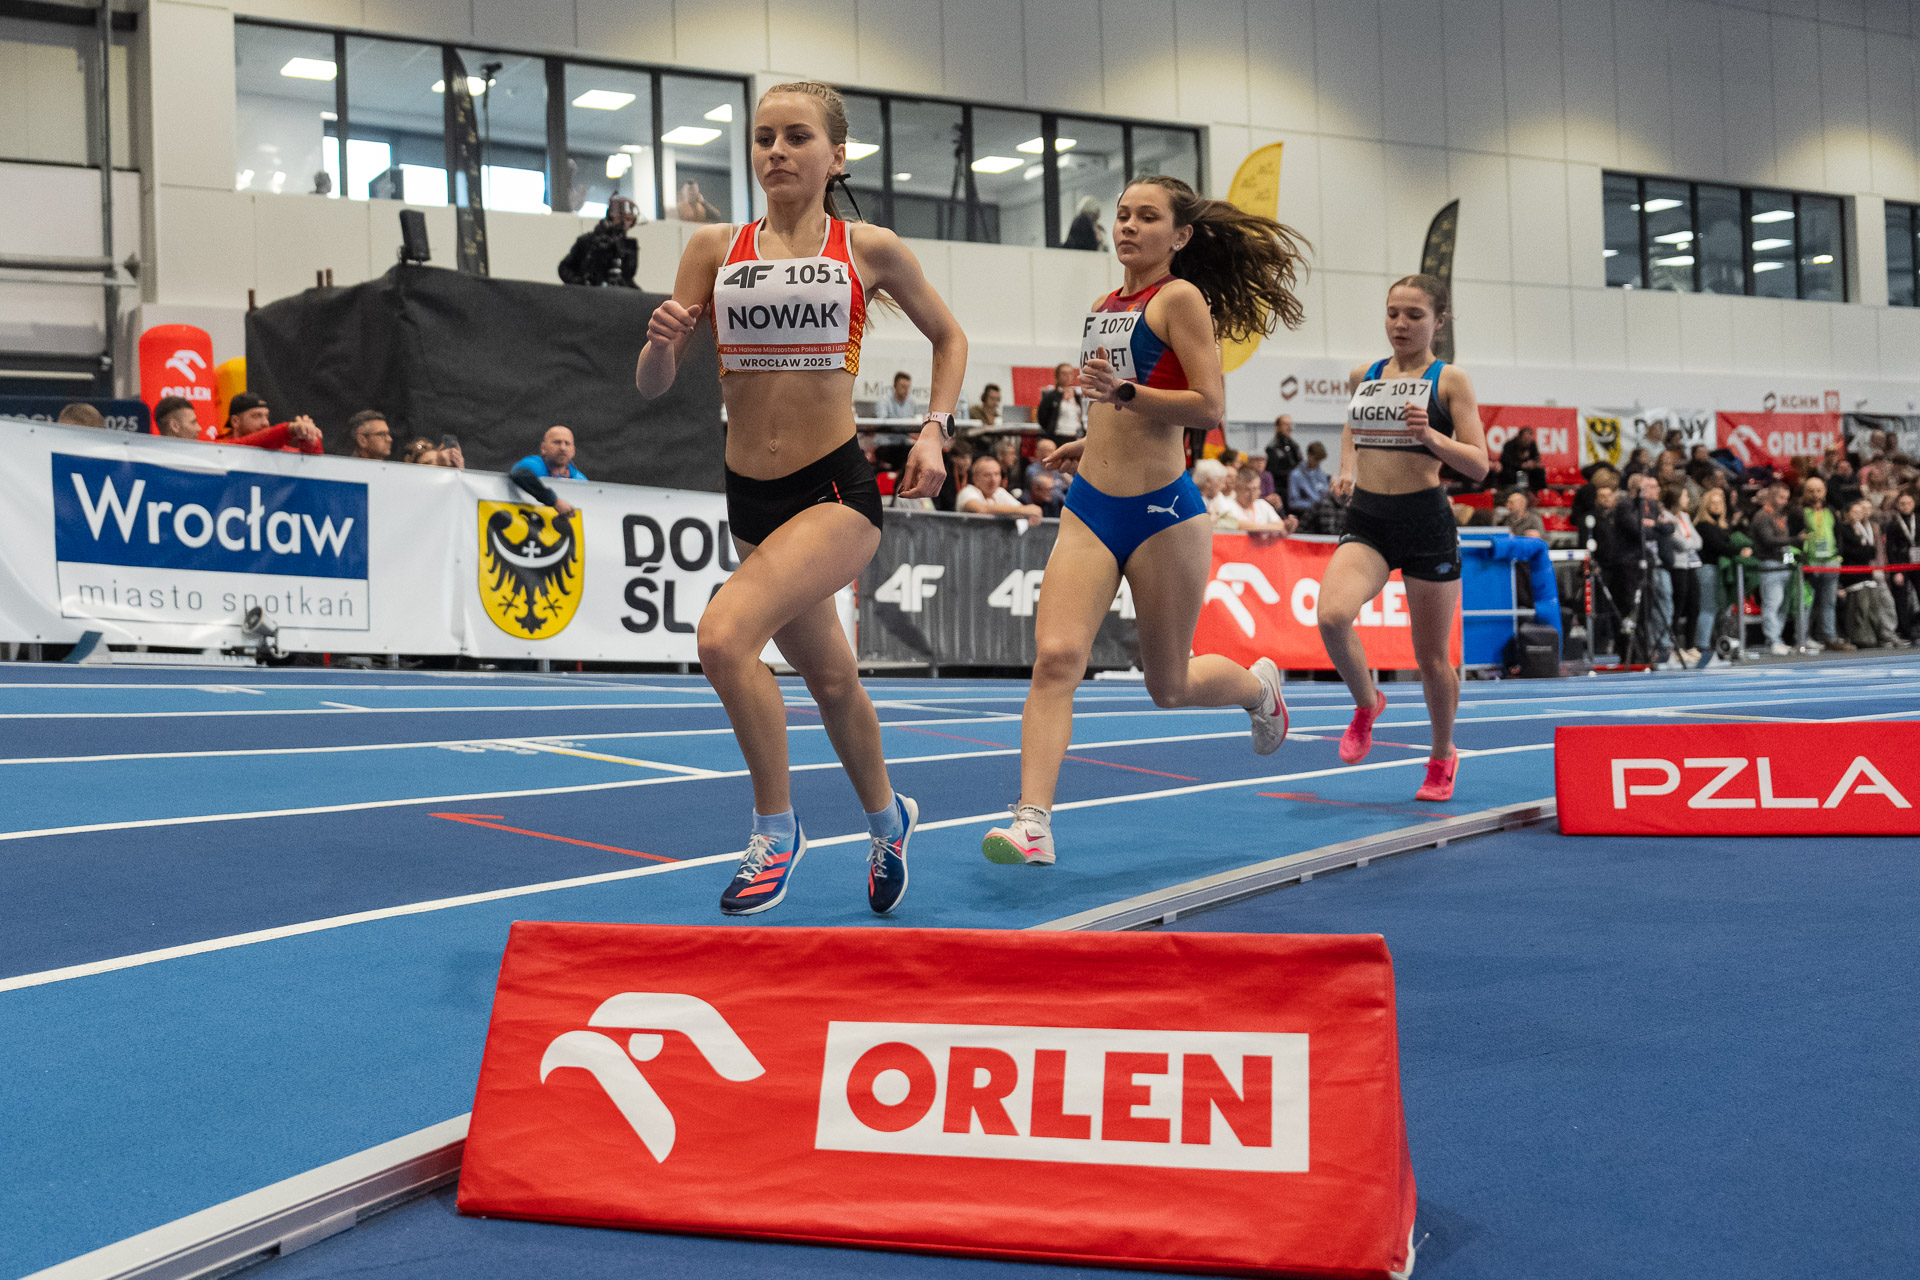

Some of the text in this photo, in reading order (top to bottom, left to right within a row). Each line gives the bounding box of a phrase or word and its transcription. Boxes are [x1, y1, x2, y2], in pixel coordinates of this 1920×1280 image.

[723, 263, 847, 289] 4F 1051
[727, 302, 839, 330] NOWAK
[1083, 316, 1134, 338] F 1070
[740, 357, 832, 368] WROCŁAW 2025
[1391, 382, 1429, 396] 1017
[104, 415, 139, 432] 025
[1352, 406, 1406, 421] LIGENZ
[71, 472, 354, 558] Wrocław
[622, 514, 741, 572] DOL
[79, 579, 353, 617] miasto spotkań
[874, 563, 945, 612] 4F
[1611, 756, 1912, 809] PZLA
[846, 1040, 1273, 1148] ORLEN
